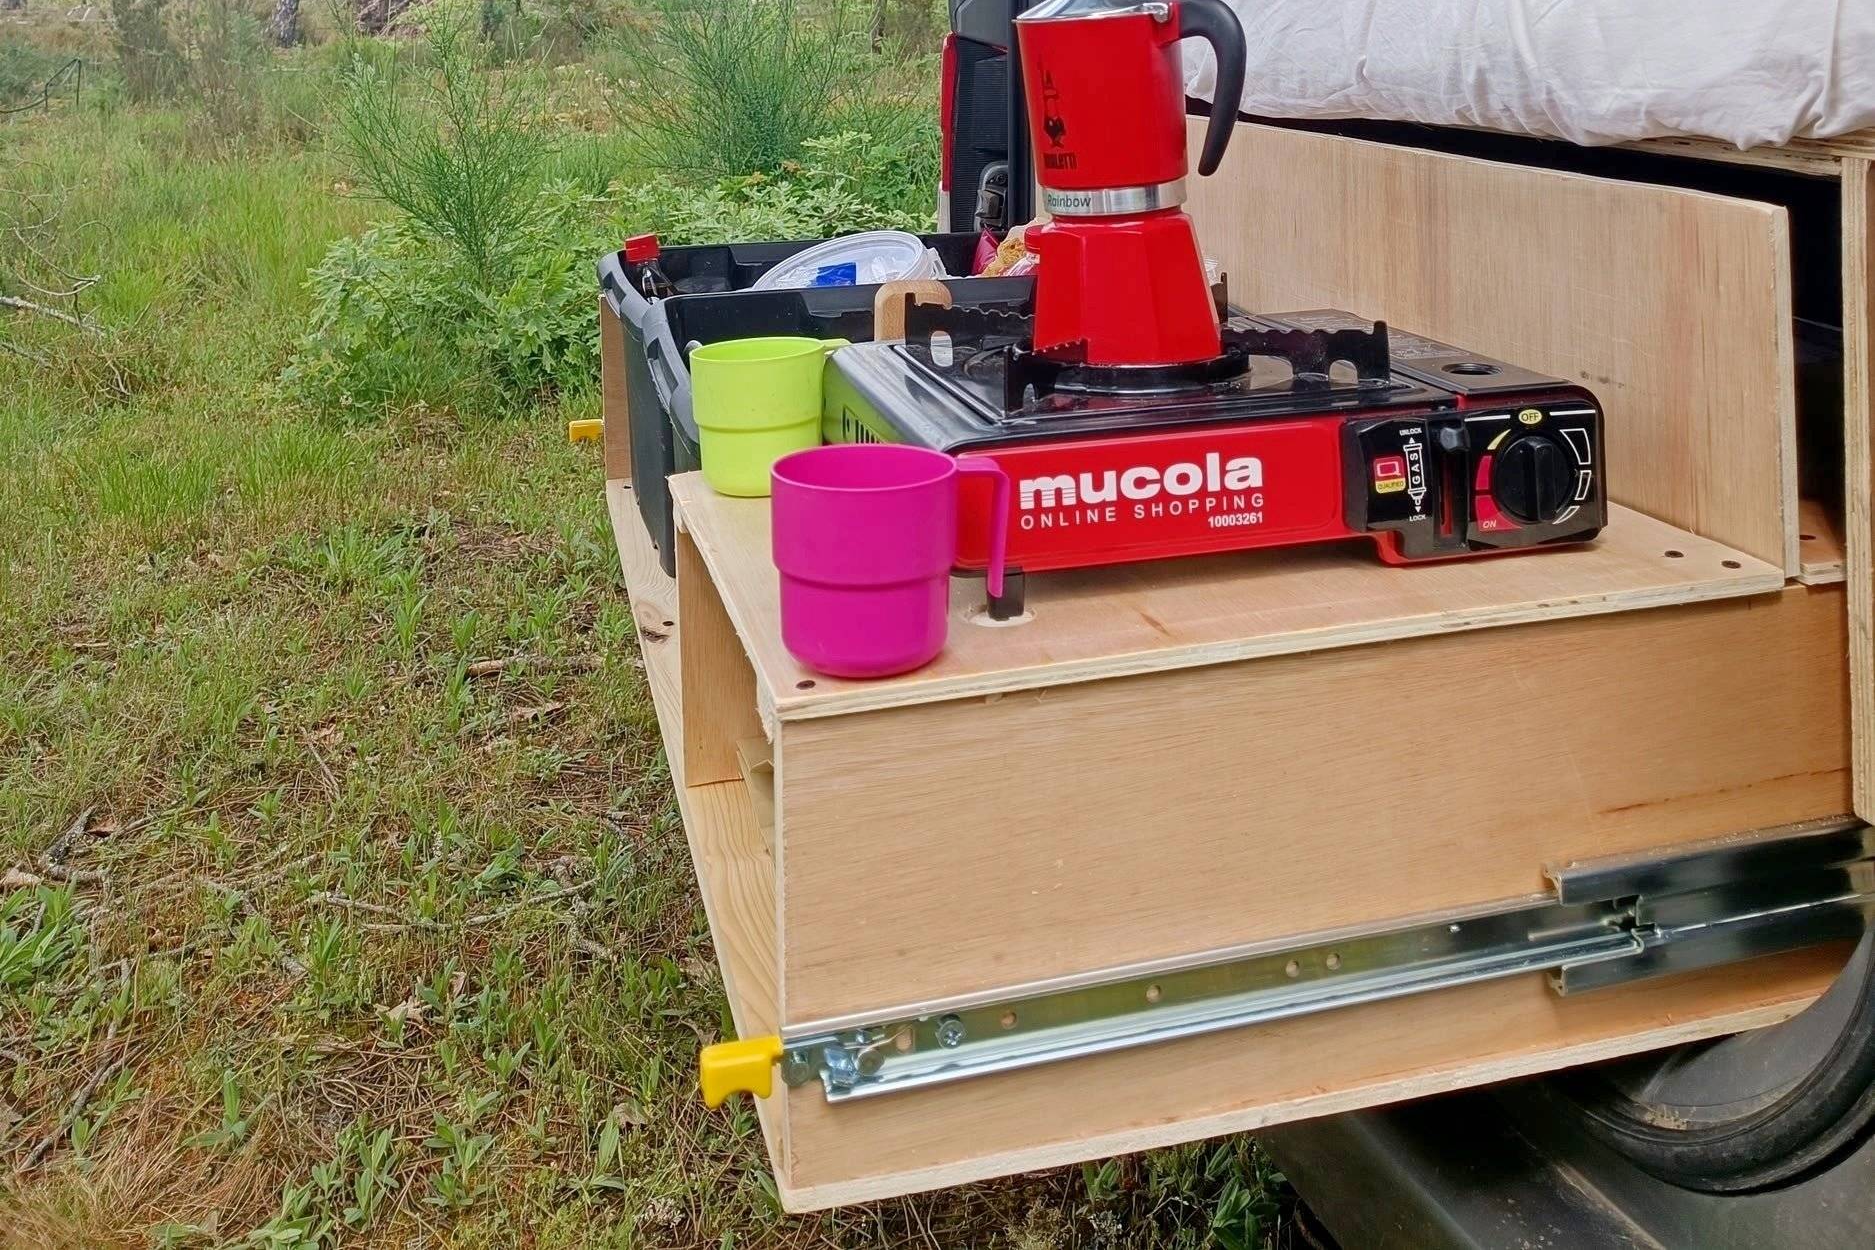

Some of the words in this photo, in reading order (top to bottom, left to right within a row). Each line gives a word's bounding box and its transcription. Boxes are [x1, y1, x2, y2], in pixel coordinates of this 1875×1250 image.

[1047, 193, 1091, 208] Rainbow
[1521, 413, 1539, 422] OFF
[1399, 427, 1422, 436] UNLOCK
[1410, 452, 1421, 485] GAS
[1019, 452, 1264, 510] mucola
[1020, 506, 1116, 530] ONLINE
[1134, 493, 1264, 519] SHOPPING
[1409, 513, 1427, 522] LOCK
[1208, 511, 1263, 528] 10003261
[1482, 520, 1497, 529] ON
